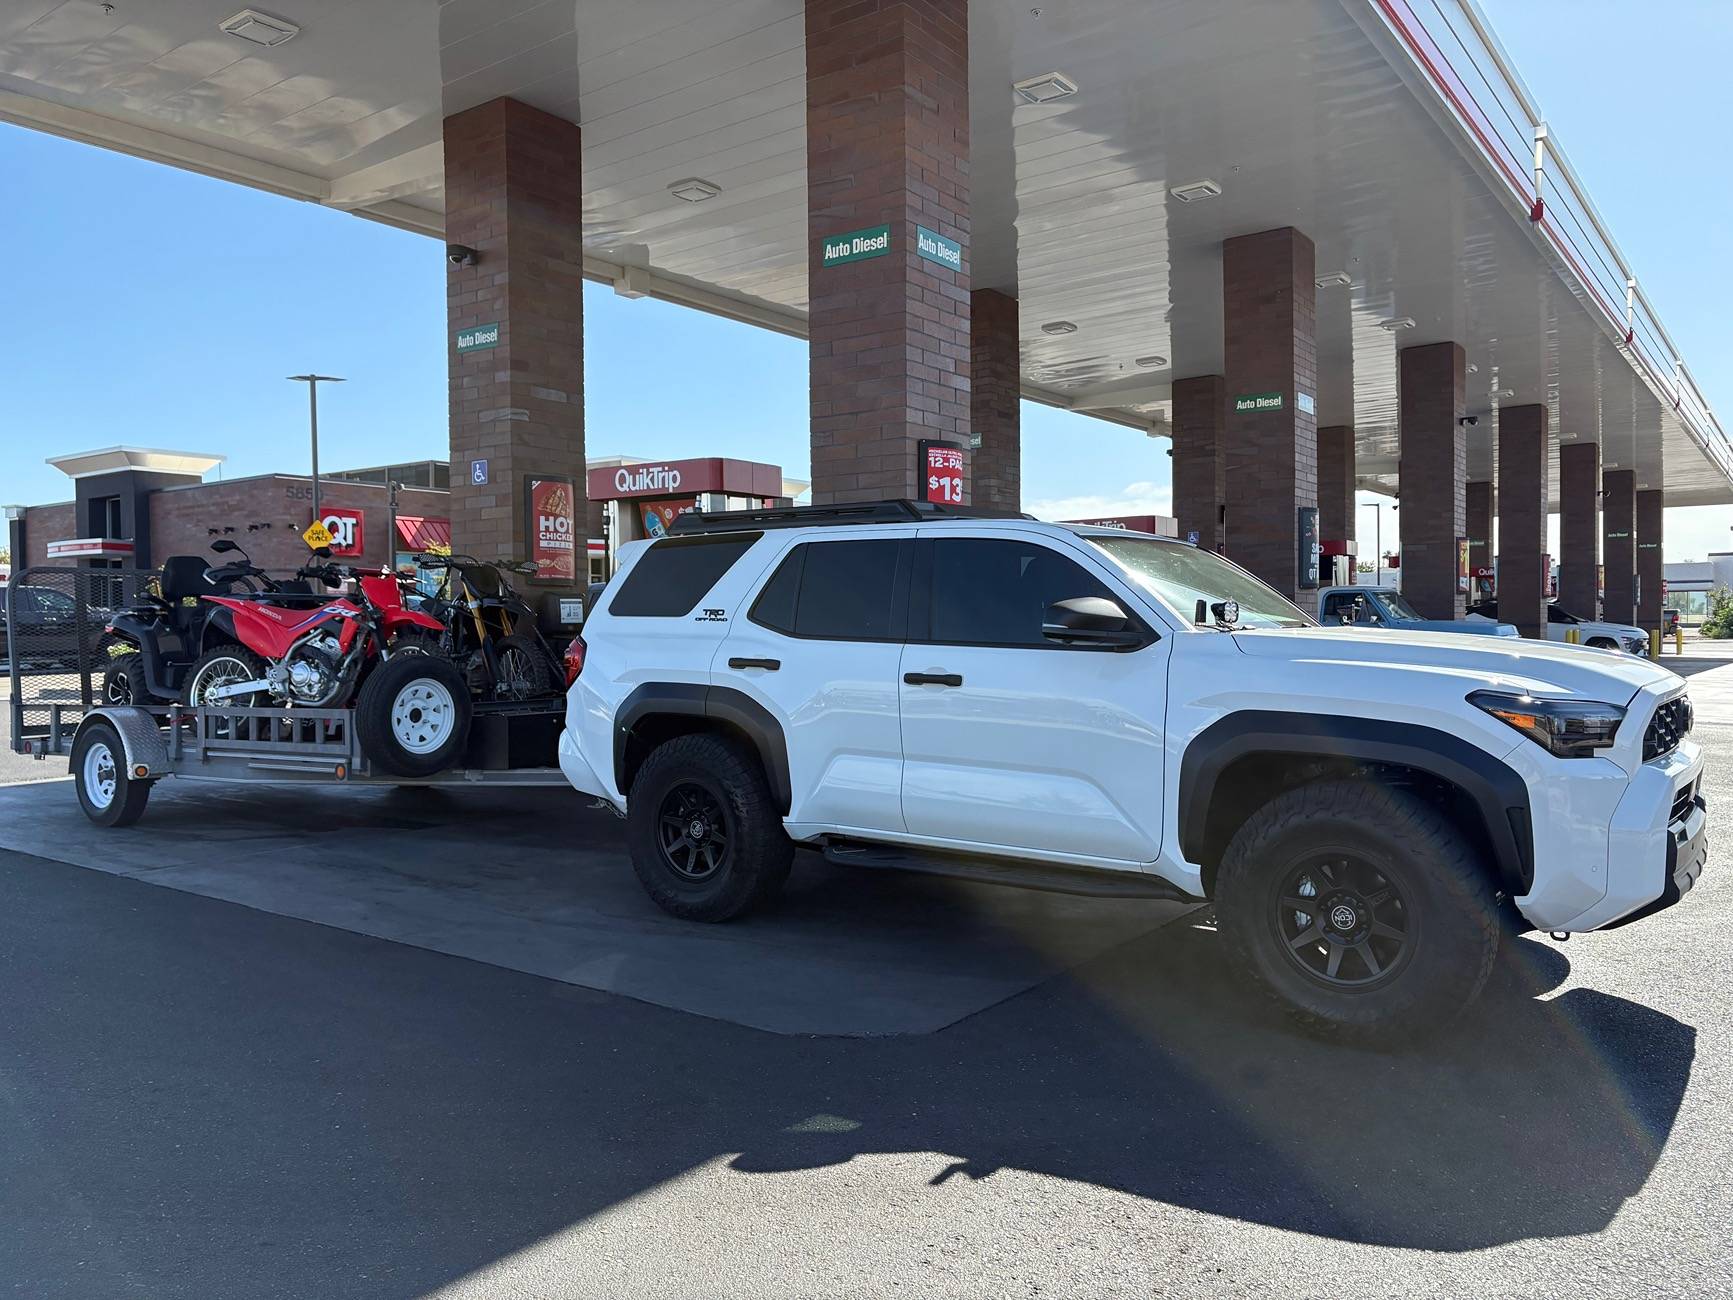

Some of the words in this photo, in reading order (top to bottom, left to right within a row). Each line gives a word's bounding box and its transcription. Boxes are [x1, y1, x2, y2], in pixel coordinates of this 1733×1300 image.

[825, 243, 850, 260] Auto
[852, 232, 887, 254] Diesel
[918, 233, 936, 255] Auto
[937, 241, 960, 265] Diesel
[457, 335, 474, 349] Auto
[475, 328, 498, 345] Diesel
[1236, 400, 1255, 410] Auto
[1256, 395, 1281, 408] Diesel
[615, 466, 681, 493] QuikTrip
[322, 515, 357, 546] QT
[539, 515, 572, 533] HOT
[258, 606, 282, 621] HONDA
[702, 609, 725, 617] TRD
